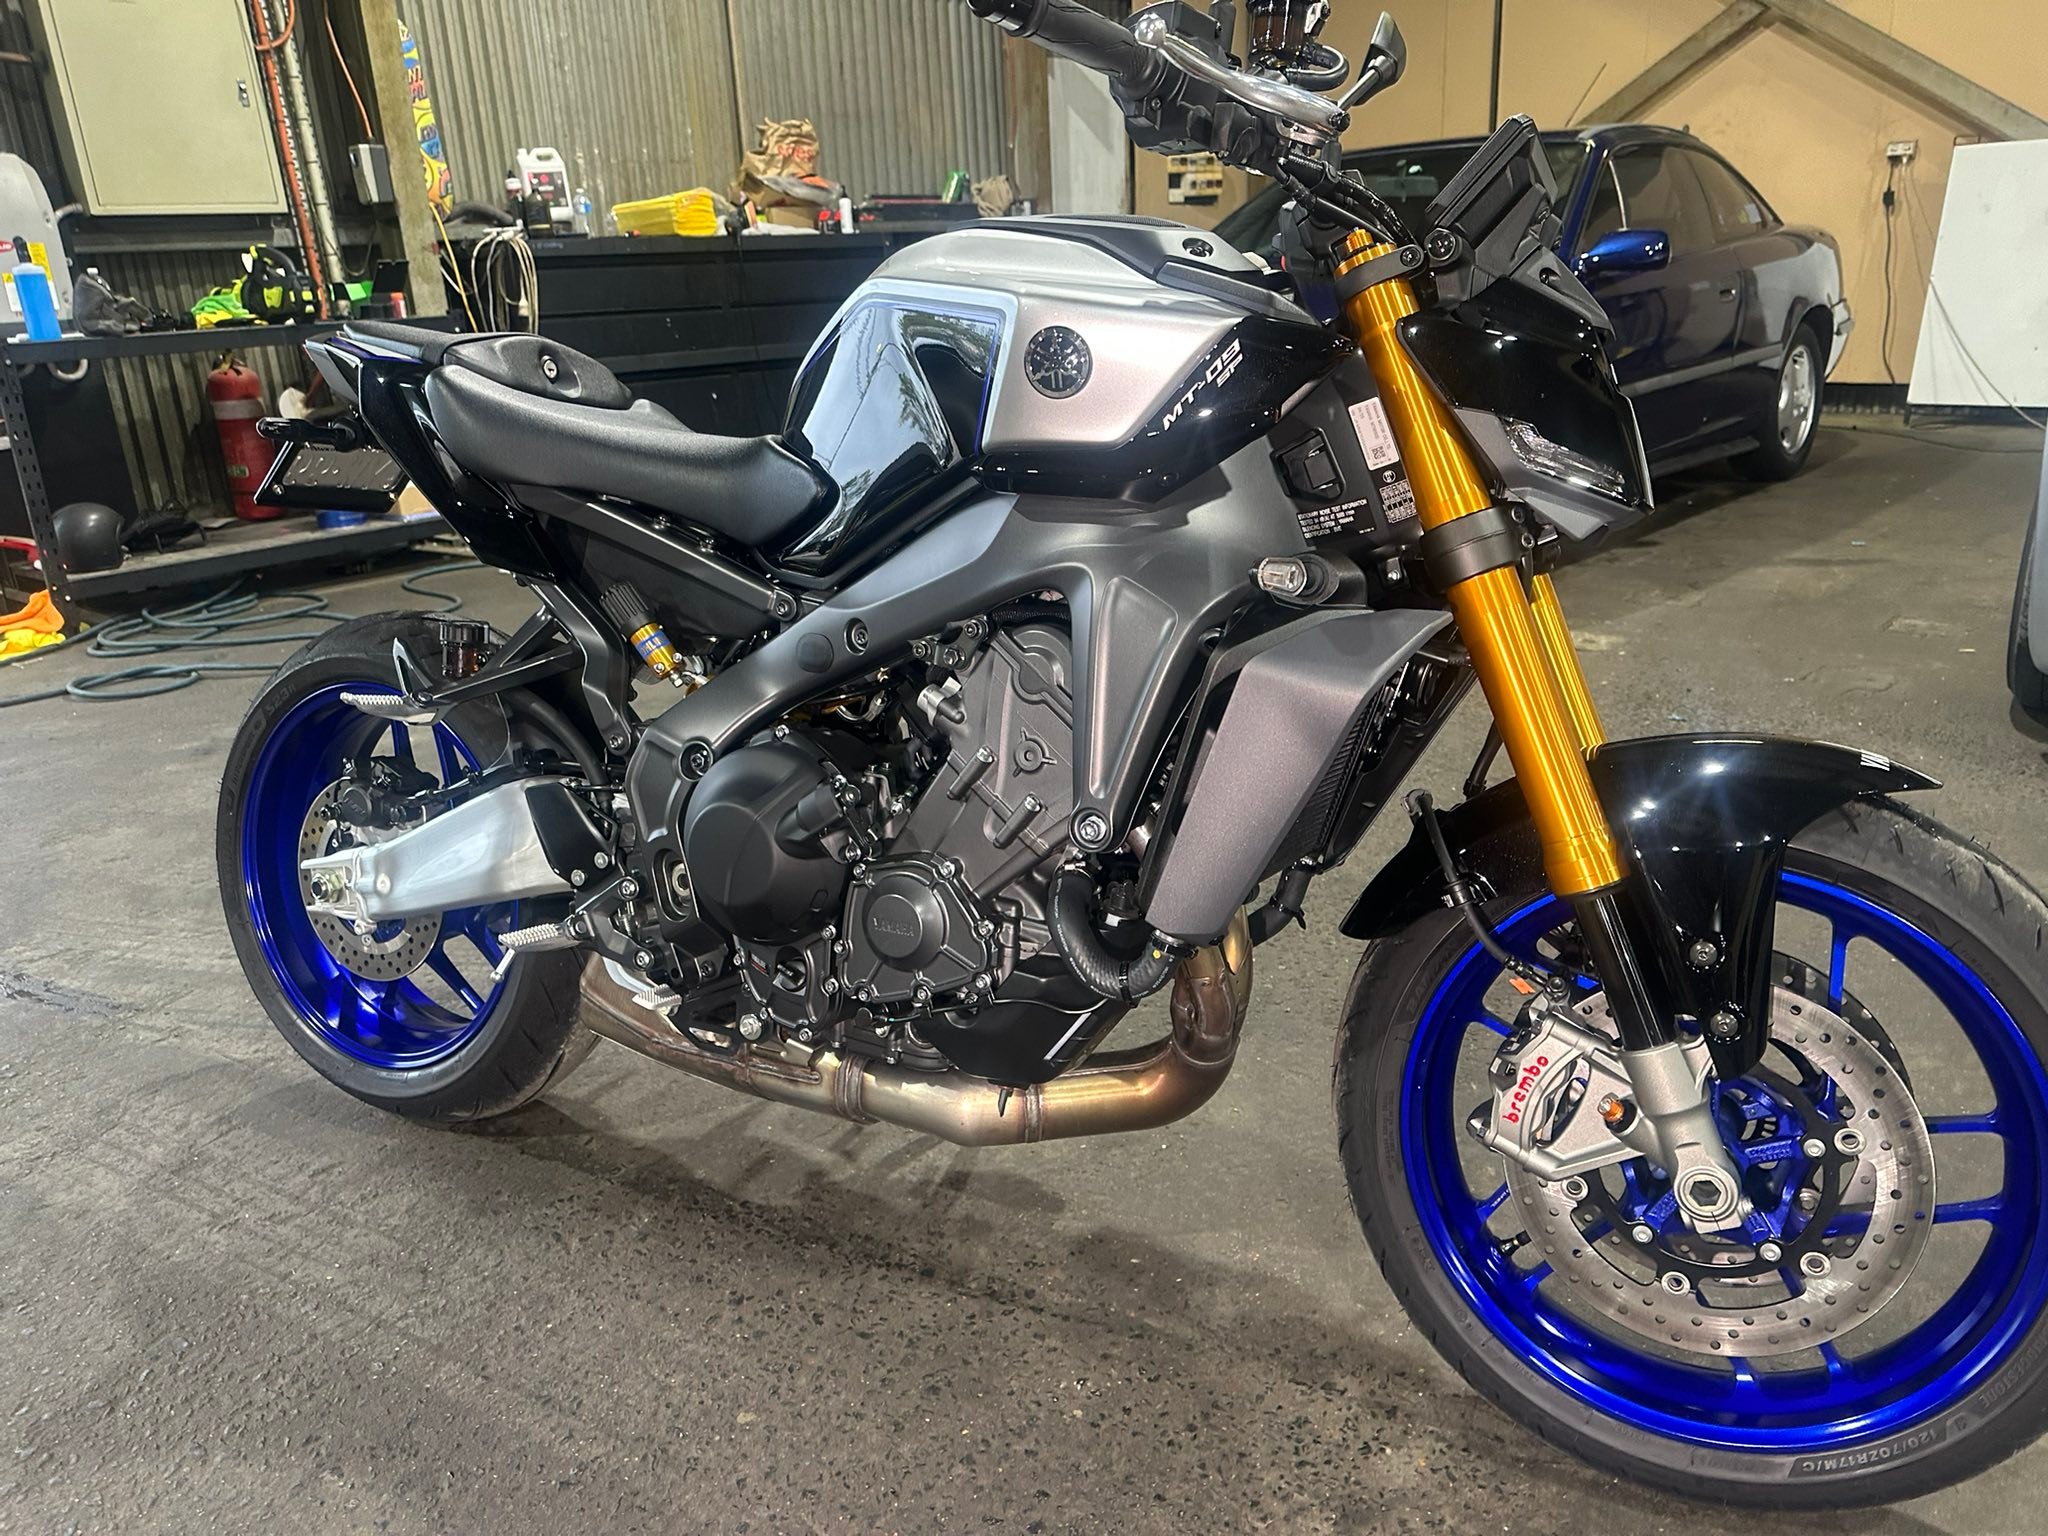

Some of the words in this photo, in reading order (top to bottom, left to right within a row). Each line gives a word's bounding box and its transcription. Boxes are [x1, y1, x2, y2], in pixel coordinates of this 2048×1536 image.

[1163, 338, 1241, 431] MT-09
[1216, 353, 1243, 388] SP
[1502, 1056, 1549, 1123] brembo
[1802, 1428, 1941, 1472] 120/70ZR17M/C
